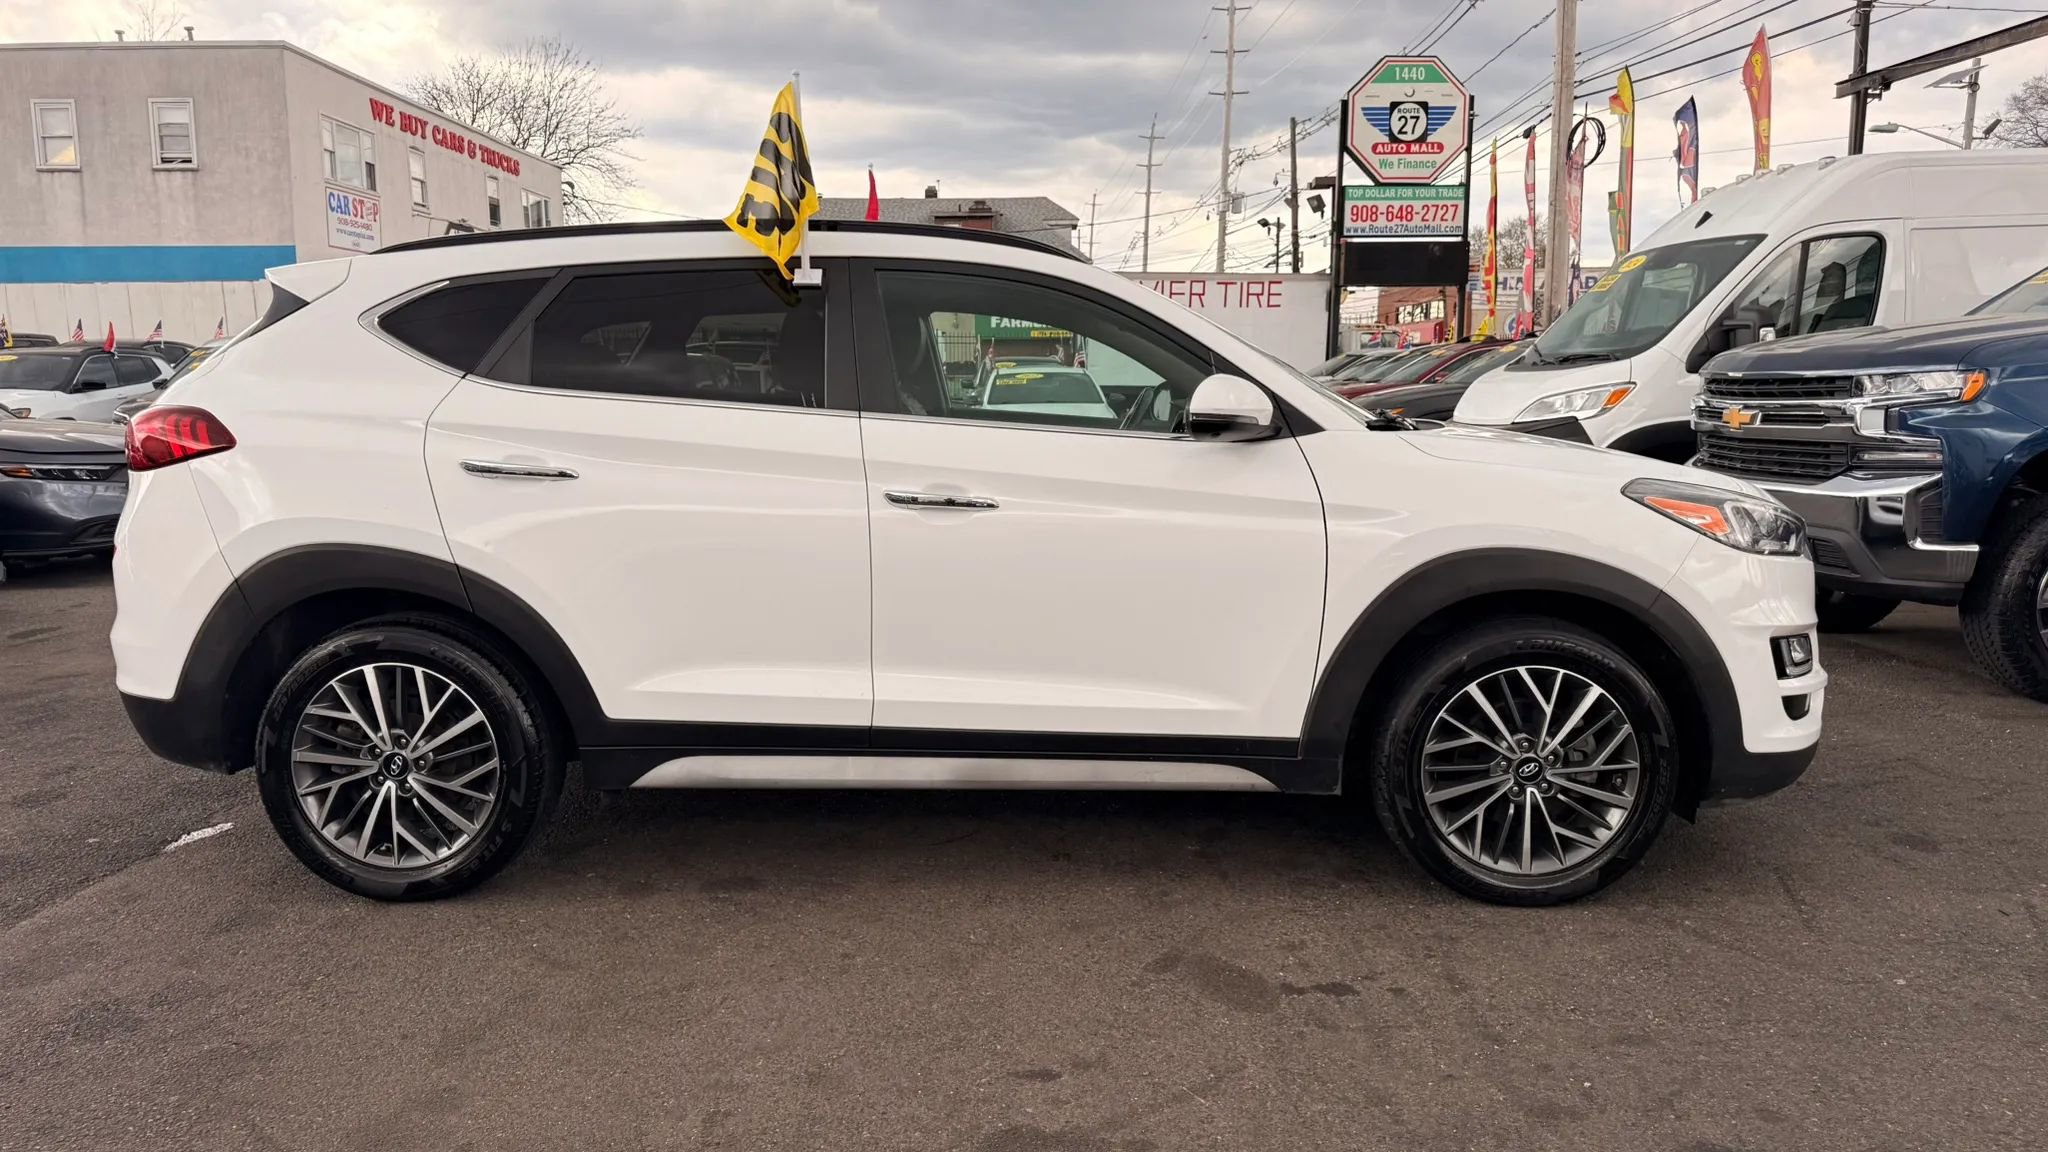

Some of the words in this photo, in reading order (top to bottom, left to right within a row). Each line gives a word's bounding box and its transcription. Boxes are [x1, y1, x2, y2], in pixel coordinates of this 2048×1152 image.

[1395, 66, 1426, 81] 1440
[1397, 115, 1420, 135] 27
[369, 97, 395, 127] WE
[399, 111, 429, 140] BUY
[432, 125, 466, 155] CARS
[467, 139, 477, 160] &
[479, 143, 521, 177] TRUCKS
[1375, 143, 1407, 153] AUTO
[1410, 143, 1440, 153] MALL
[1379, 158, 1394, 169] We
[1397, 158, 1437, 169] Finance
[1348, 189, 1363, 198] TOP
[1365, 189, 1395, 198] DOLLAR
[1397, 189, 1413, 197] FOR
[1415, 188, 1435, 197] YOUR
[1438, 188, 1465, 197] TRADE
[328, 191, 351, 216] CAR
[1350, 204, 1459, 222] 908-648-2727
[1345, 223, 1463, 234] www.Route27AutoMall.com
[1216, 280, 1283, 308] TIRE
